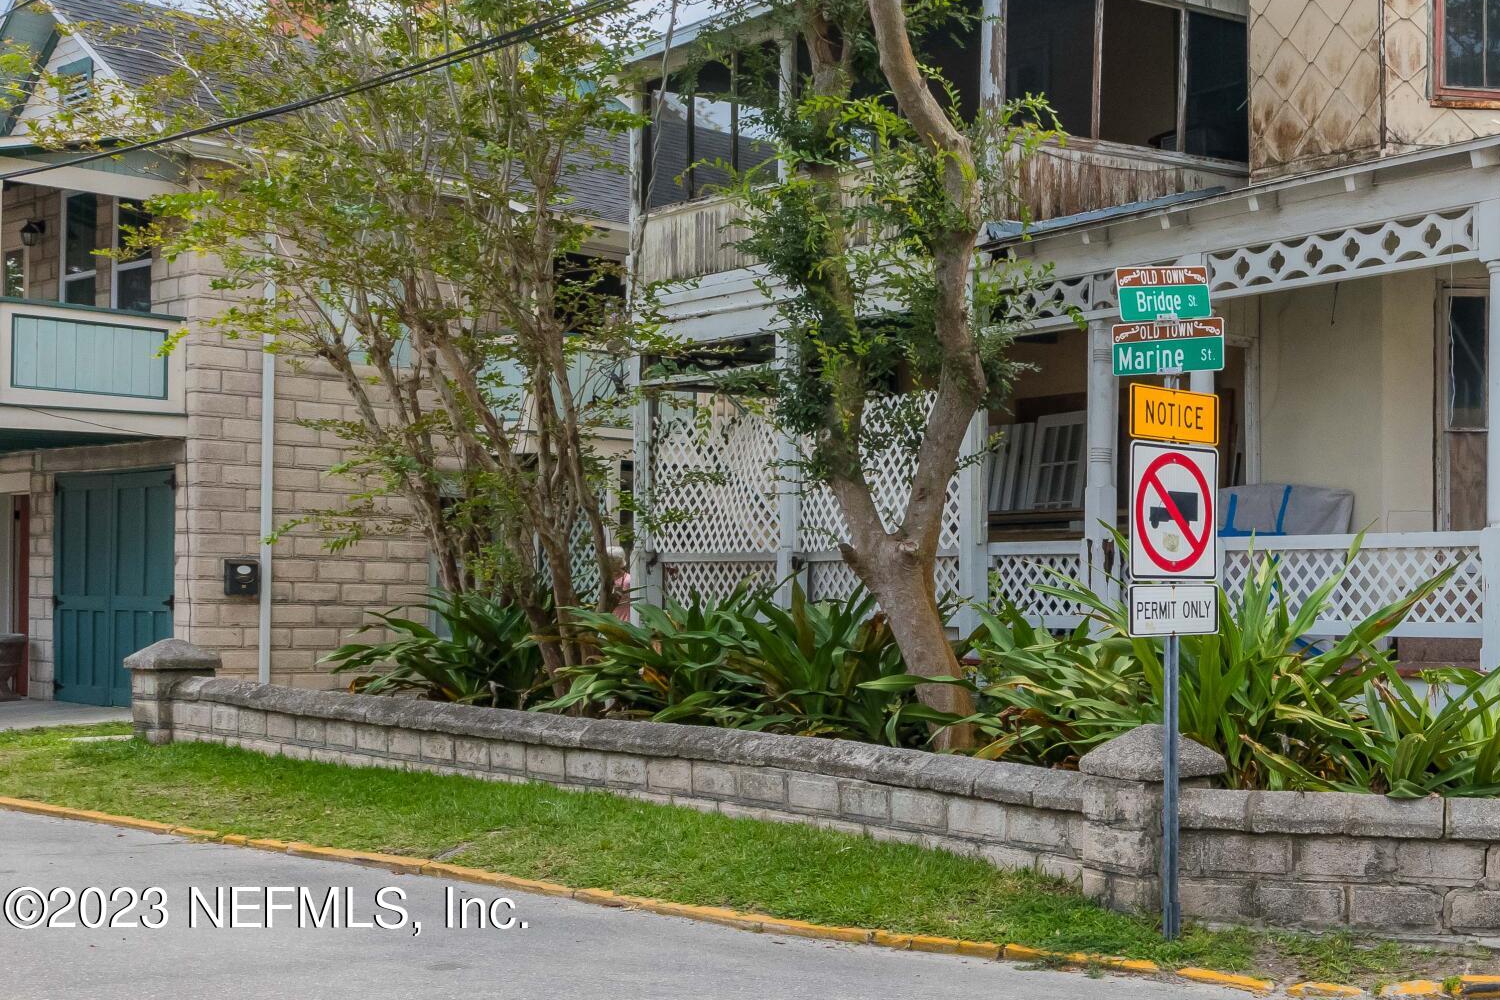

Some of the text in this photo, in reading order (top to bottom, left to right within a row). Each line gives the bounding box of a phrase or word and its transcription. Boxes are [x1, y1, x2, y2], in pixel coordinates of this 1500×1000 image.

[1140, 269, 1186, 284] OLD TOWN
[1136, 291, 1182, 314] Bridge
[1140, 322, 1194, 339] OLD TOWN
[1118, 345, 1216, 371] Marine St.
[1145, 399, 1204, 431] NOTICE
[1136, 600, 1212, 620] PERMIT ONLY
